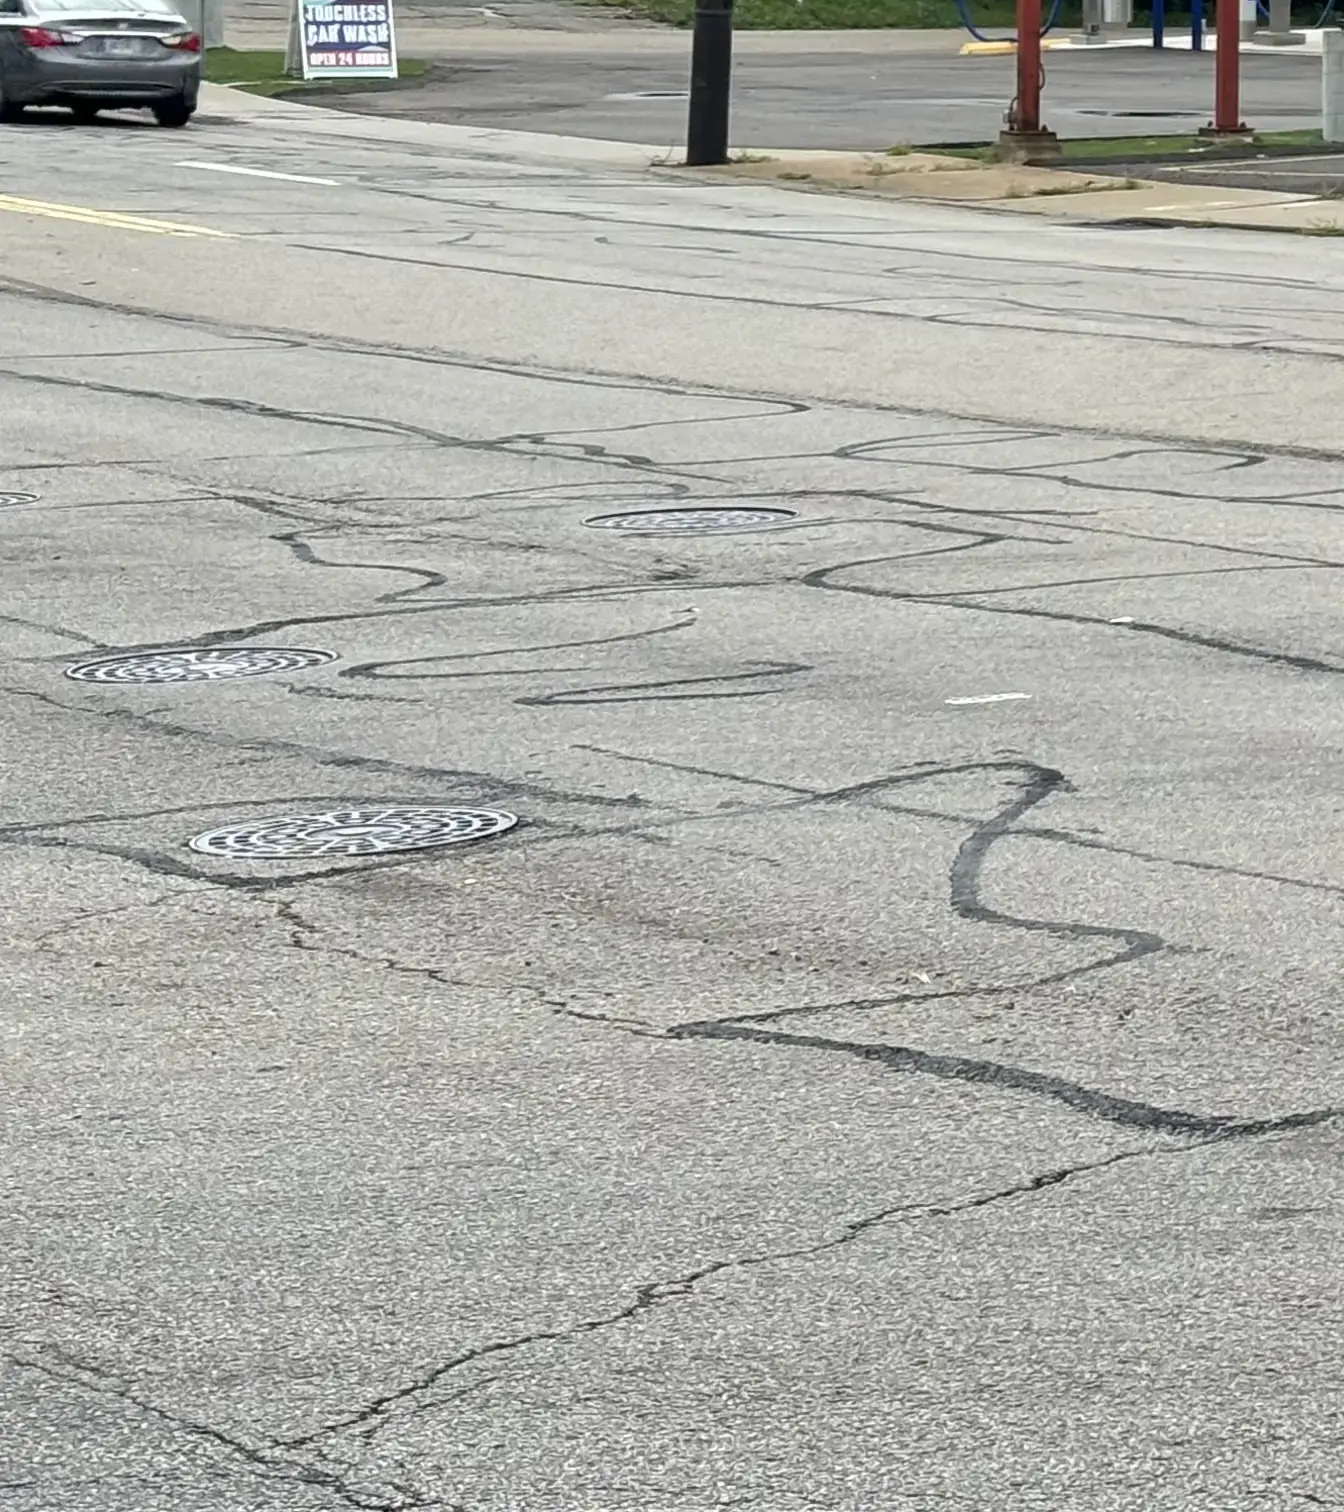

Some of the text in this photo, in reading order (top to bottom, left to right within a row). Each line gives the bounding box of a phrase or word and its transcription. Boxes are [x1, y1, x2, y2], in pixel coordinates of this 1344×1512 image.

[305, 4, 387, 22] TOUCHLESS
[307, 22, 389, 46] CAR WASH
[338, 52, 353, 65] 24
